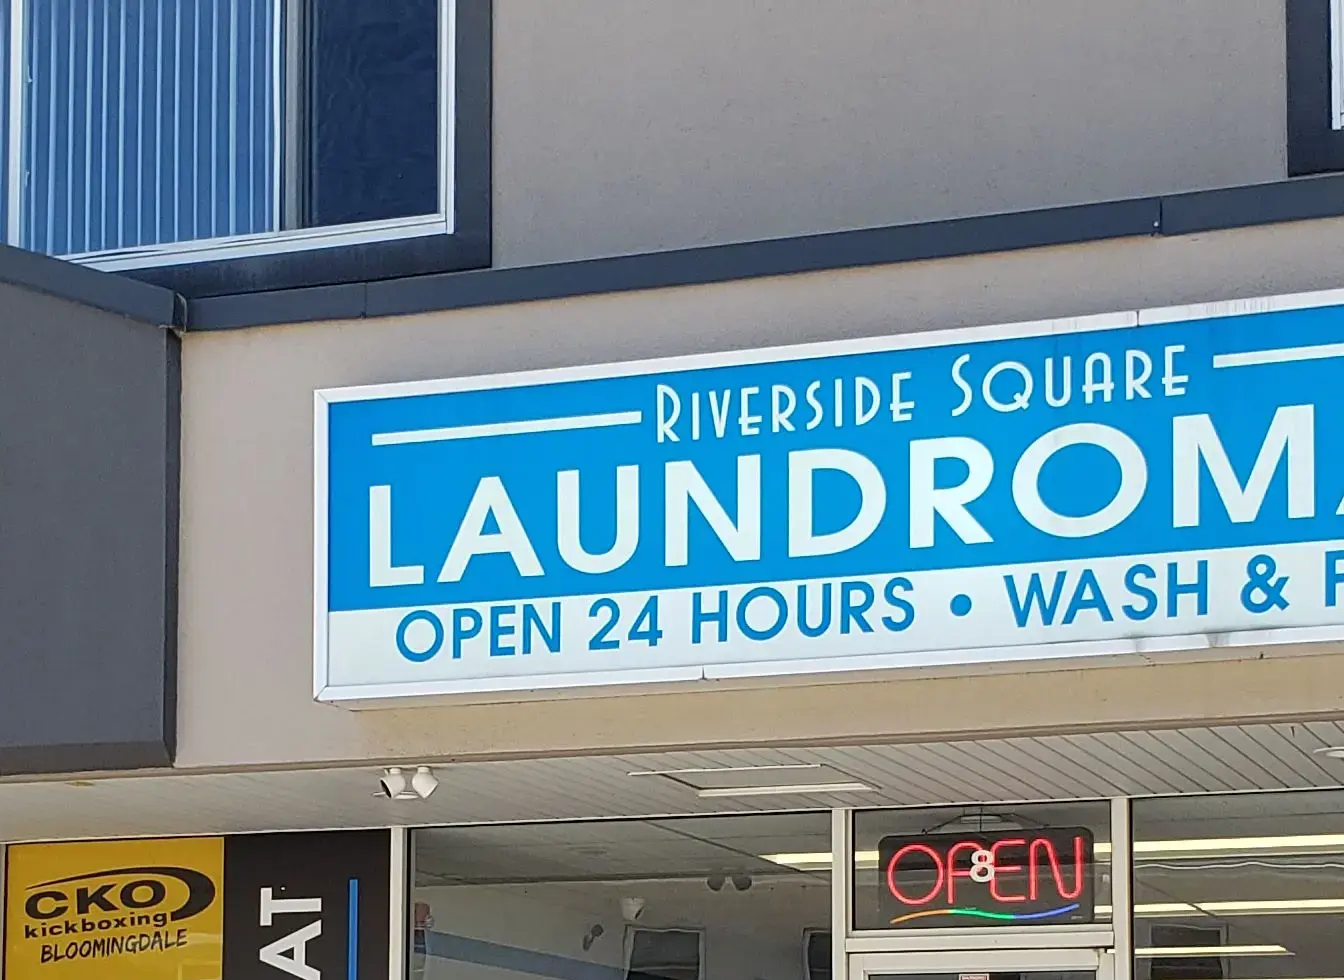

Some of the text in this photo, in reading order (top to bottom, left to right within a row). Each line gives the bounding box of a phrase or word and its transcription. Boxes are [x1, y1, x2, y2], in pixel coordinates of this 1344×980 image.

[657, 345, 1188, 443] RIVERSIDE SQUARE
[395, 601, 562, 663] OPEN
[588, 594, 662, 651] 24
[691, 577, 915, 645] HOURS
[1004, 559, 1209, 628] WASH
[1240, 553, 1291, 613] &
[887, 836, 1085, 905] OPEN
[969, 849, 996, 883] 8
[24, 879, 167, 921] CKO
[24, 911, 168, 940] kickboxing
[40, 928, 189, 965] BLOOMINGDALE
